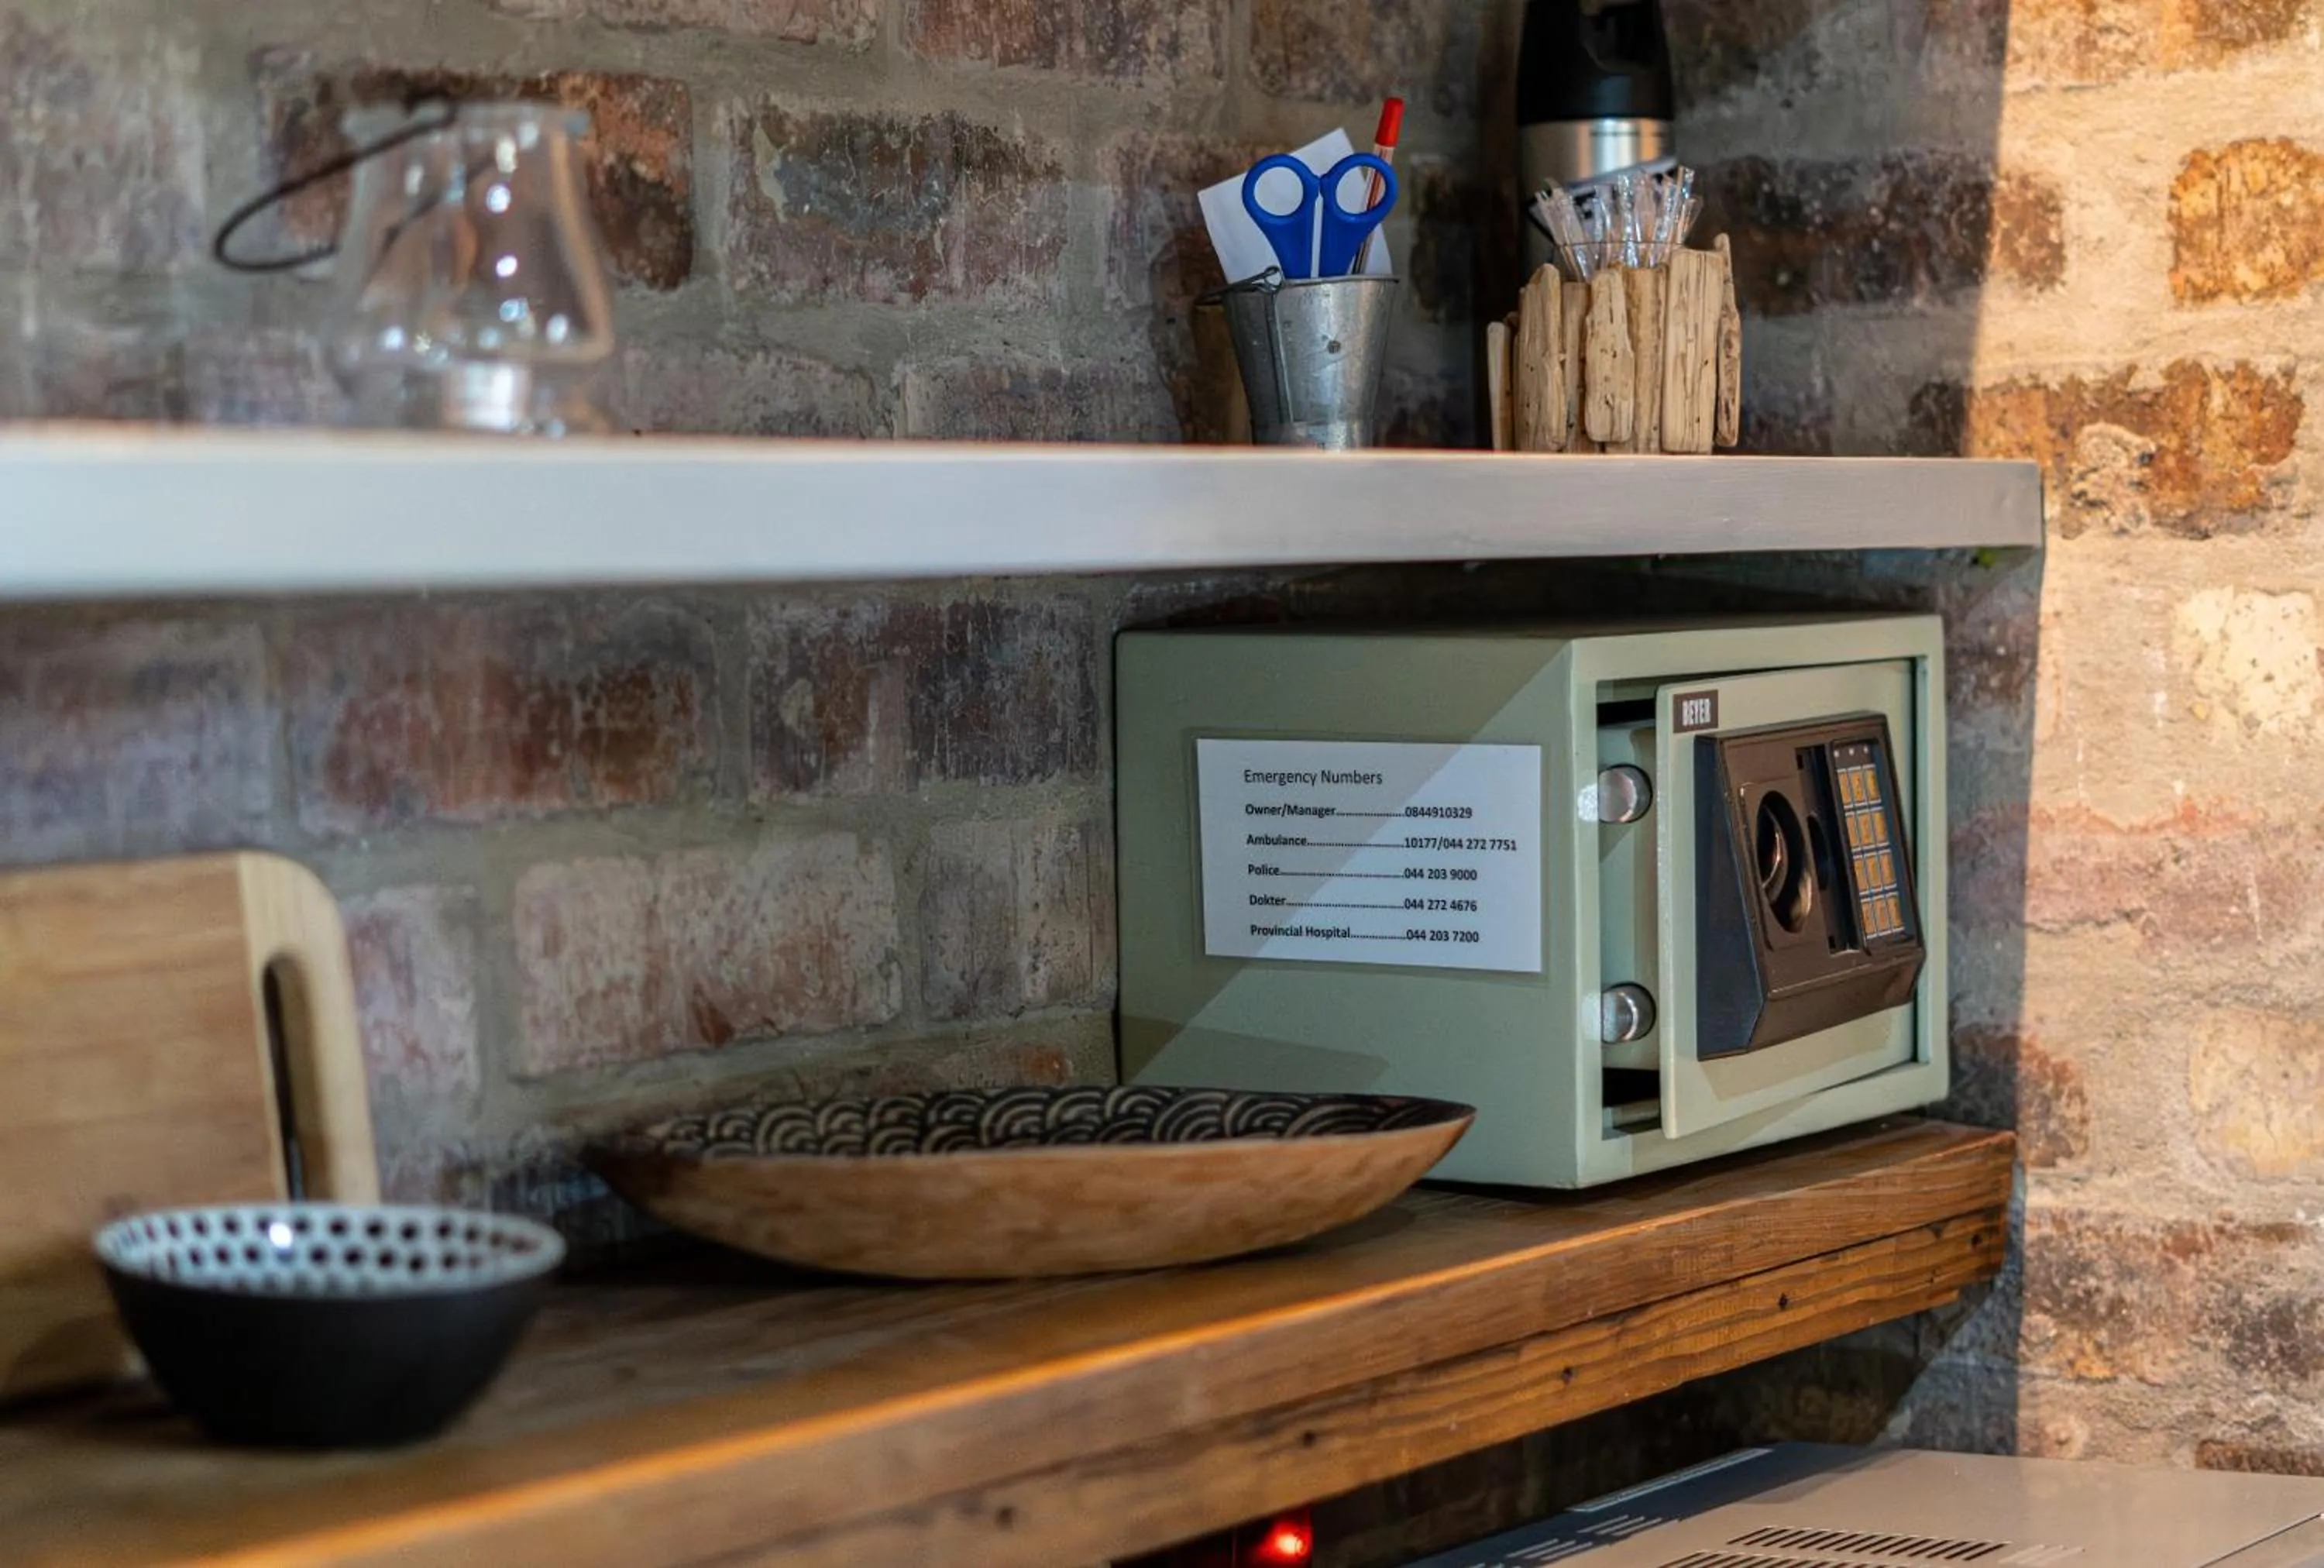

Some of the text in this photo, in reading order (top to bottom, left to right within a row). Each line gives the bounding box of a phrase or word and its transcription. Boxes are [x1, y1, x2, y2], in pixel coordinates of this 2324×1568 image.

[1244, 769, 1383, 786] Emergency Numbers
[1245, 803, 1336, 818] Owner/Manager
[1246, 834, 1308, 846] Ambulance
[1490, 839, 1518, 851] 7751
[1248, 864, 1477, 882] Police 044 203 9000
[1250, 895, 1477, 912] Dokter 044 272 4676
[1250, 925, 1479, 943] Provincial Hospital 044 203 7200
